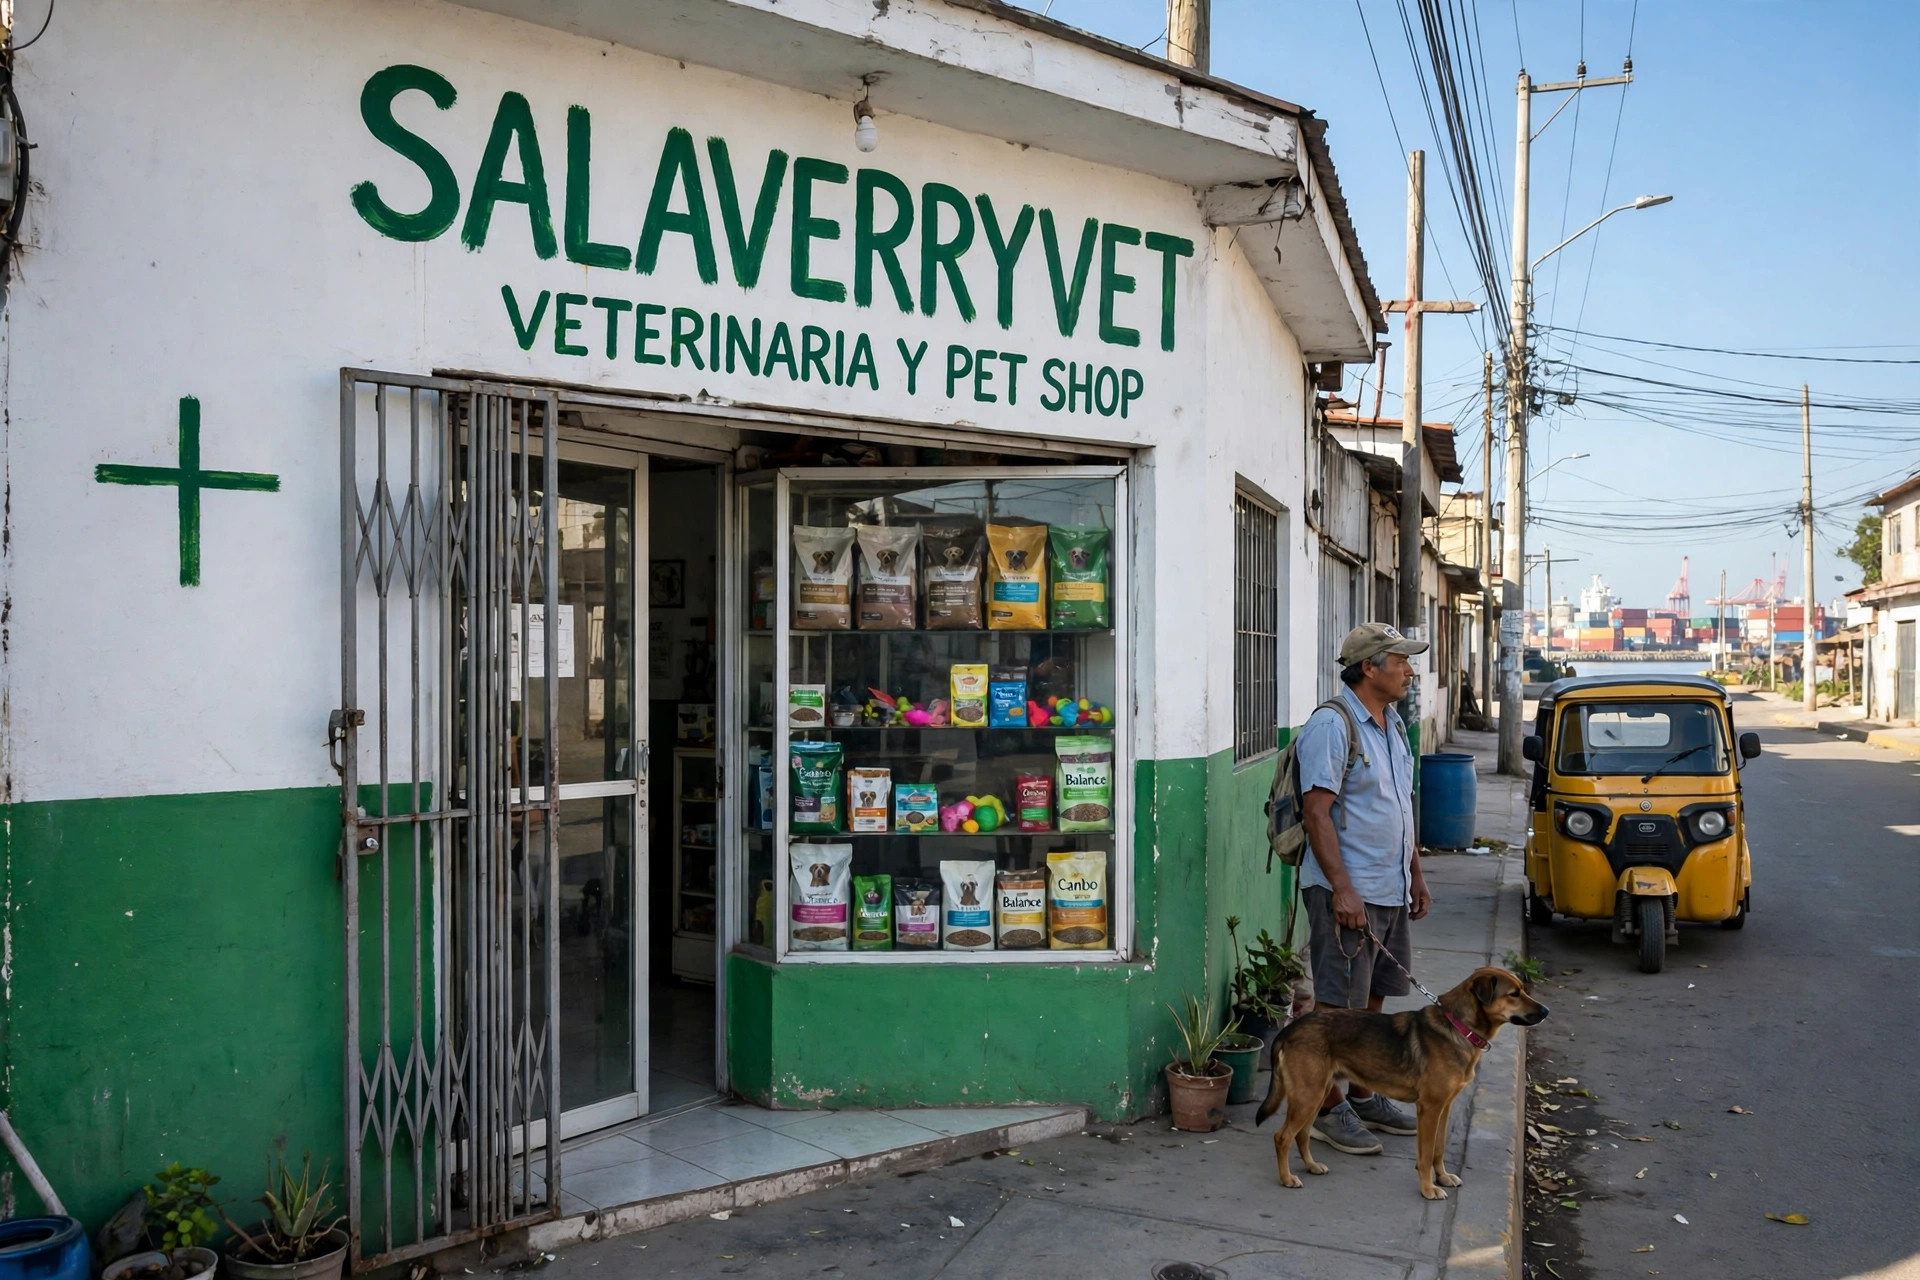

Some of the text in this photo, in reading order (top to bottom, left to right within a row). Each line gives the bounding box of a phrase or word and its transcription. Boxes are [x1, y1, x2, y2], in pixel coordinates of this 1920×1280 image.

[351, 64, 1193, 352] SALAVERRYVET
[501, 284, 1144, 419] VETERINARIA Y PET SHOP
[1065, 774, 1106, 785] Balance
[1058, 878, 1098, 891] Canbo
[1003, 896, 1041, 908] Balance
